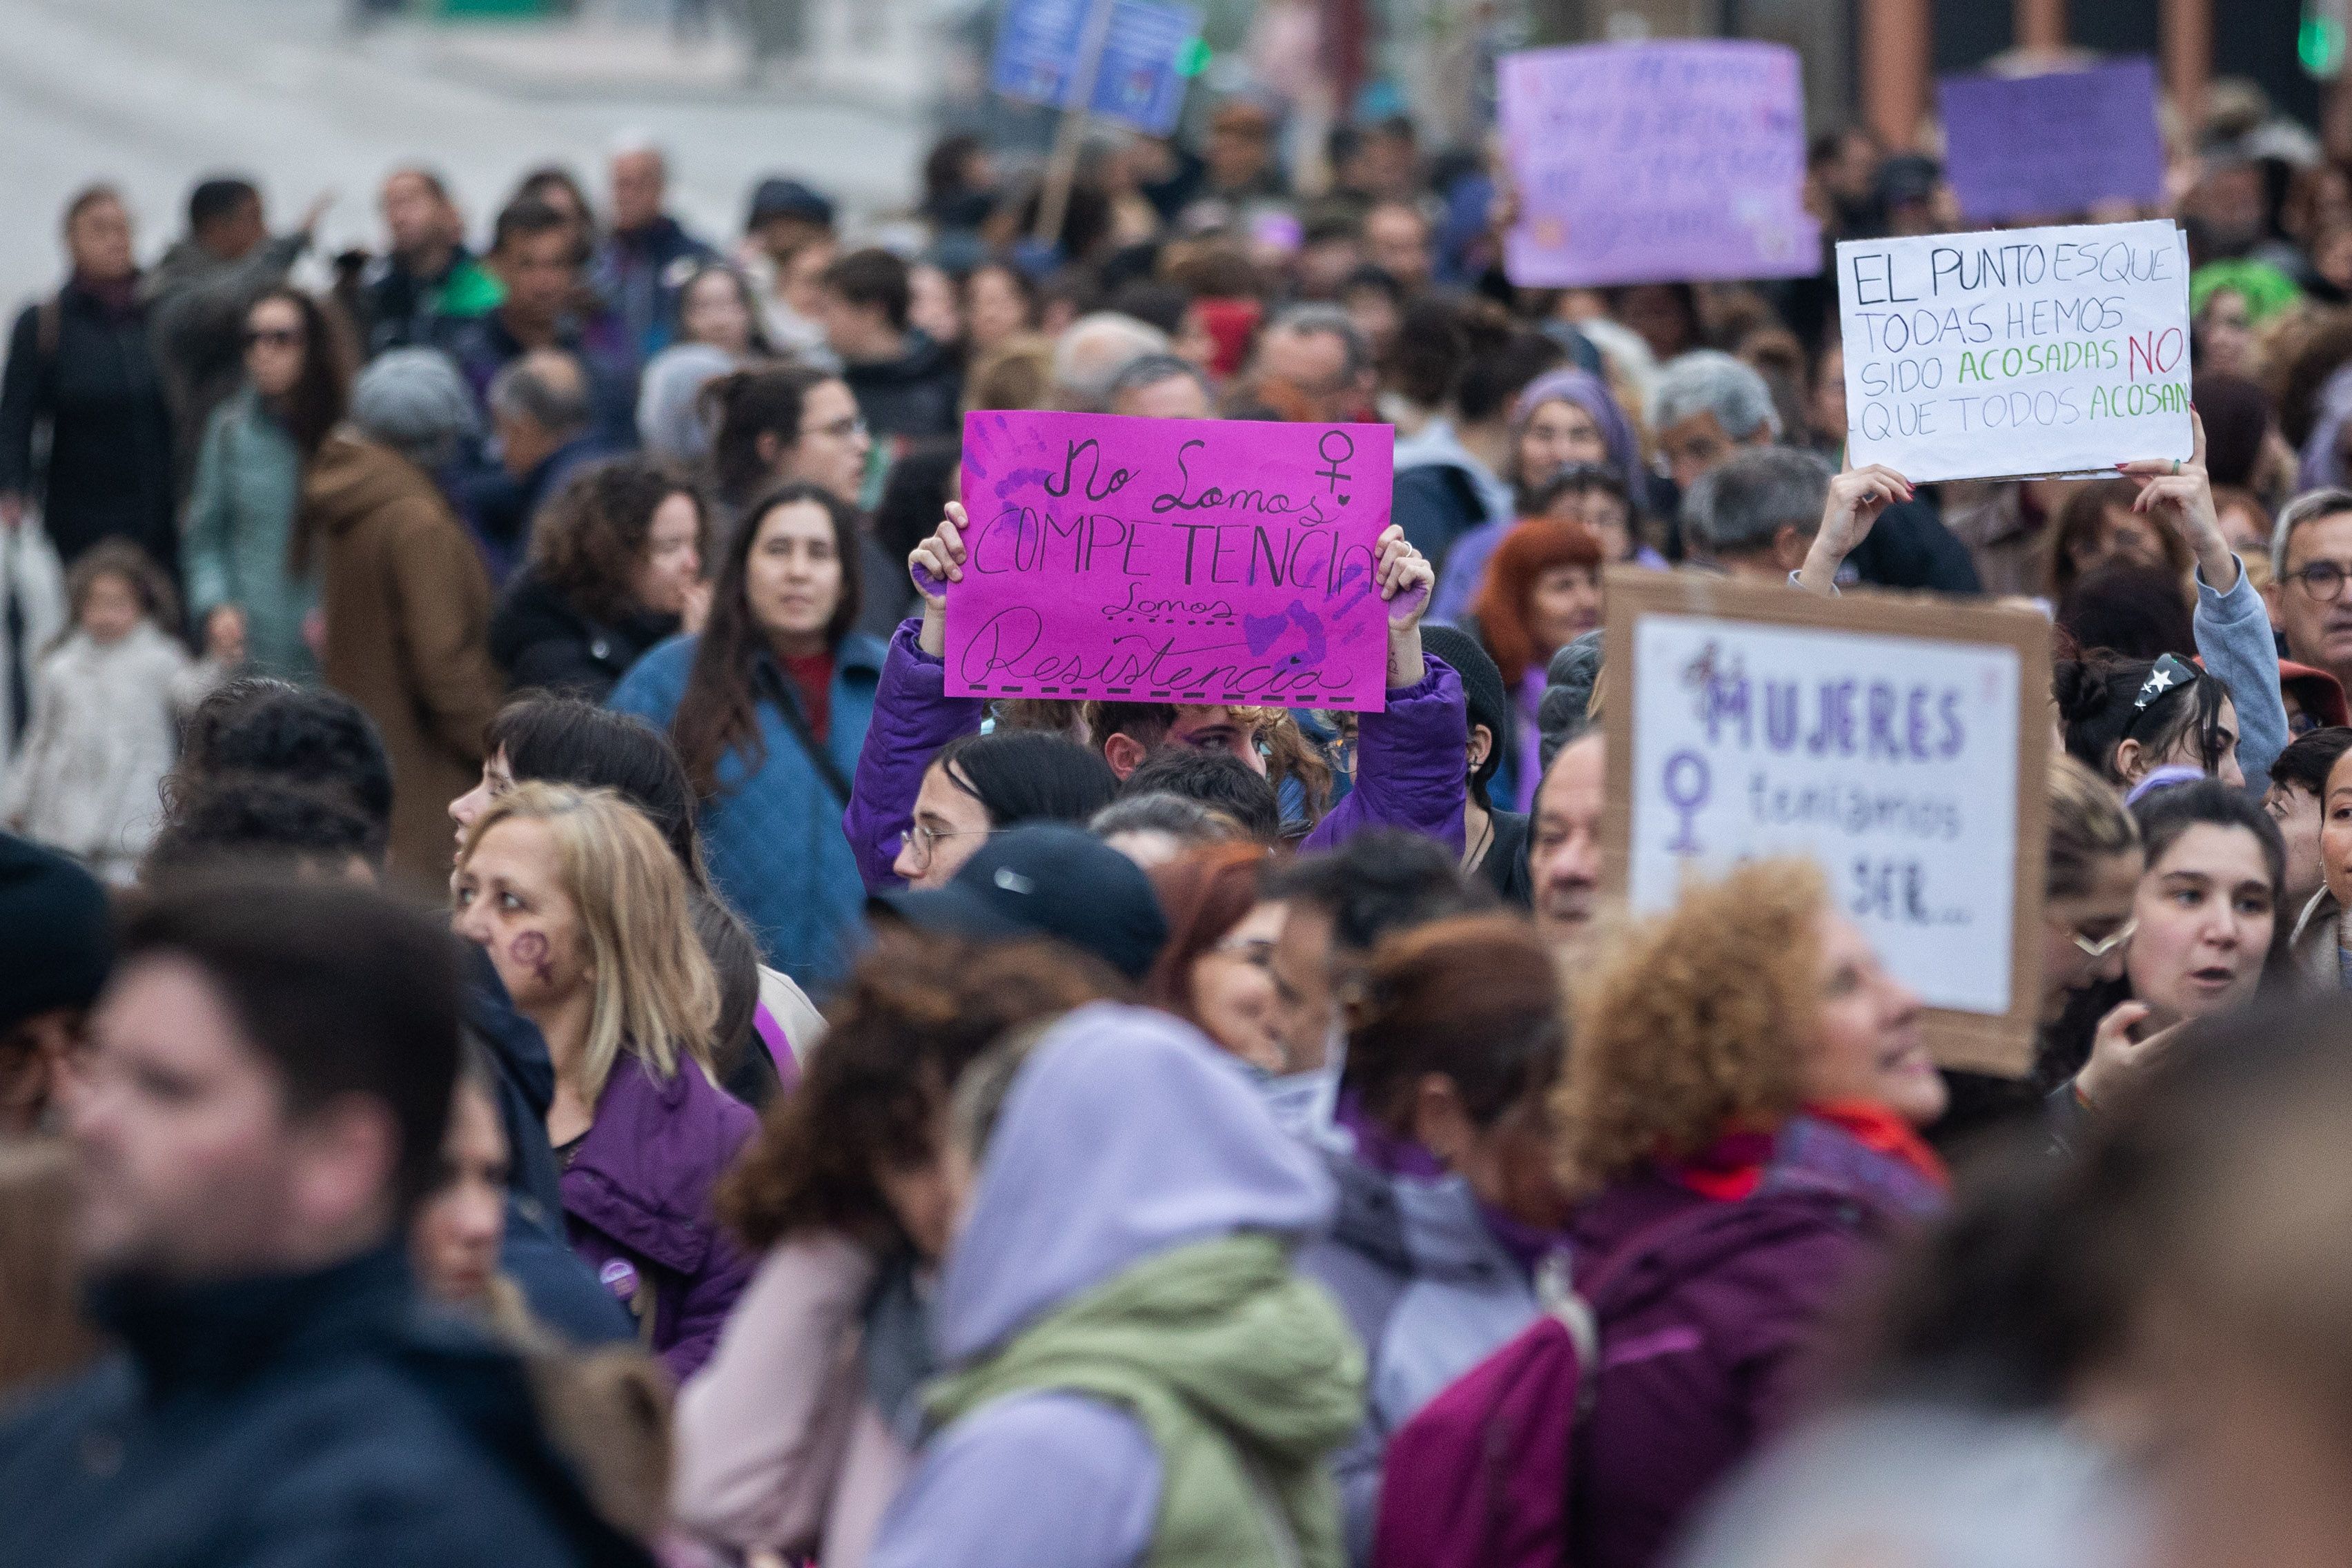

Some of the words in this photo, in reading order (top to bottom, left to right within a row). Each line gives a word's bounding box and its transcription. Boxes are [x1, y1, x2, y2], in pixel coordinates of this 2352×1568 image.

[1853, 253, 1919, 305] EL
[1932, 243, 2046, 296] PUNTO
[1855, 303, 1993, 353] TODAS
[2006, 296, 2126, 340] HEMOS
[1861, 357, 1943, 397] SIDO
[1958, 340, 2119, 384] ACOSADAS
[2128, 327, 2184, 382] NO
[1862, 400, 1938, 441] QUE
[1948, 387, 2081, 432] TODOS
[2089, 382, 2190, 420] ACOSAN
[1043, 438, 1141, 502] No
[974, 506, 1375, 596] COMPETENCIA
[1101, 582, 1239, 618] Somos
[961, 606, 1354, 694] Resistencia
[1705, 673, 1966, 765] MUJERES
